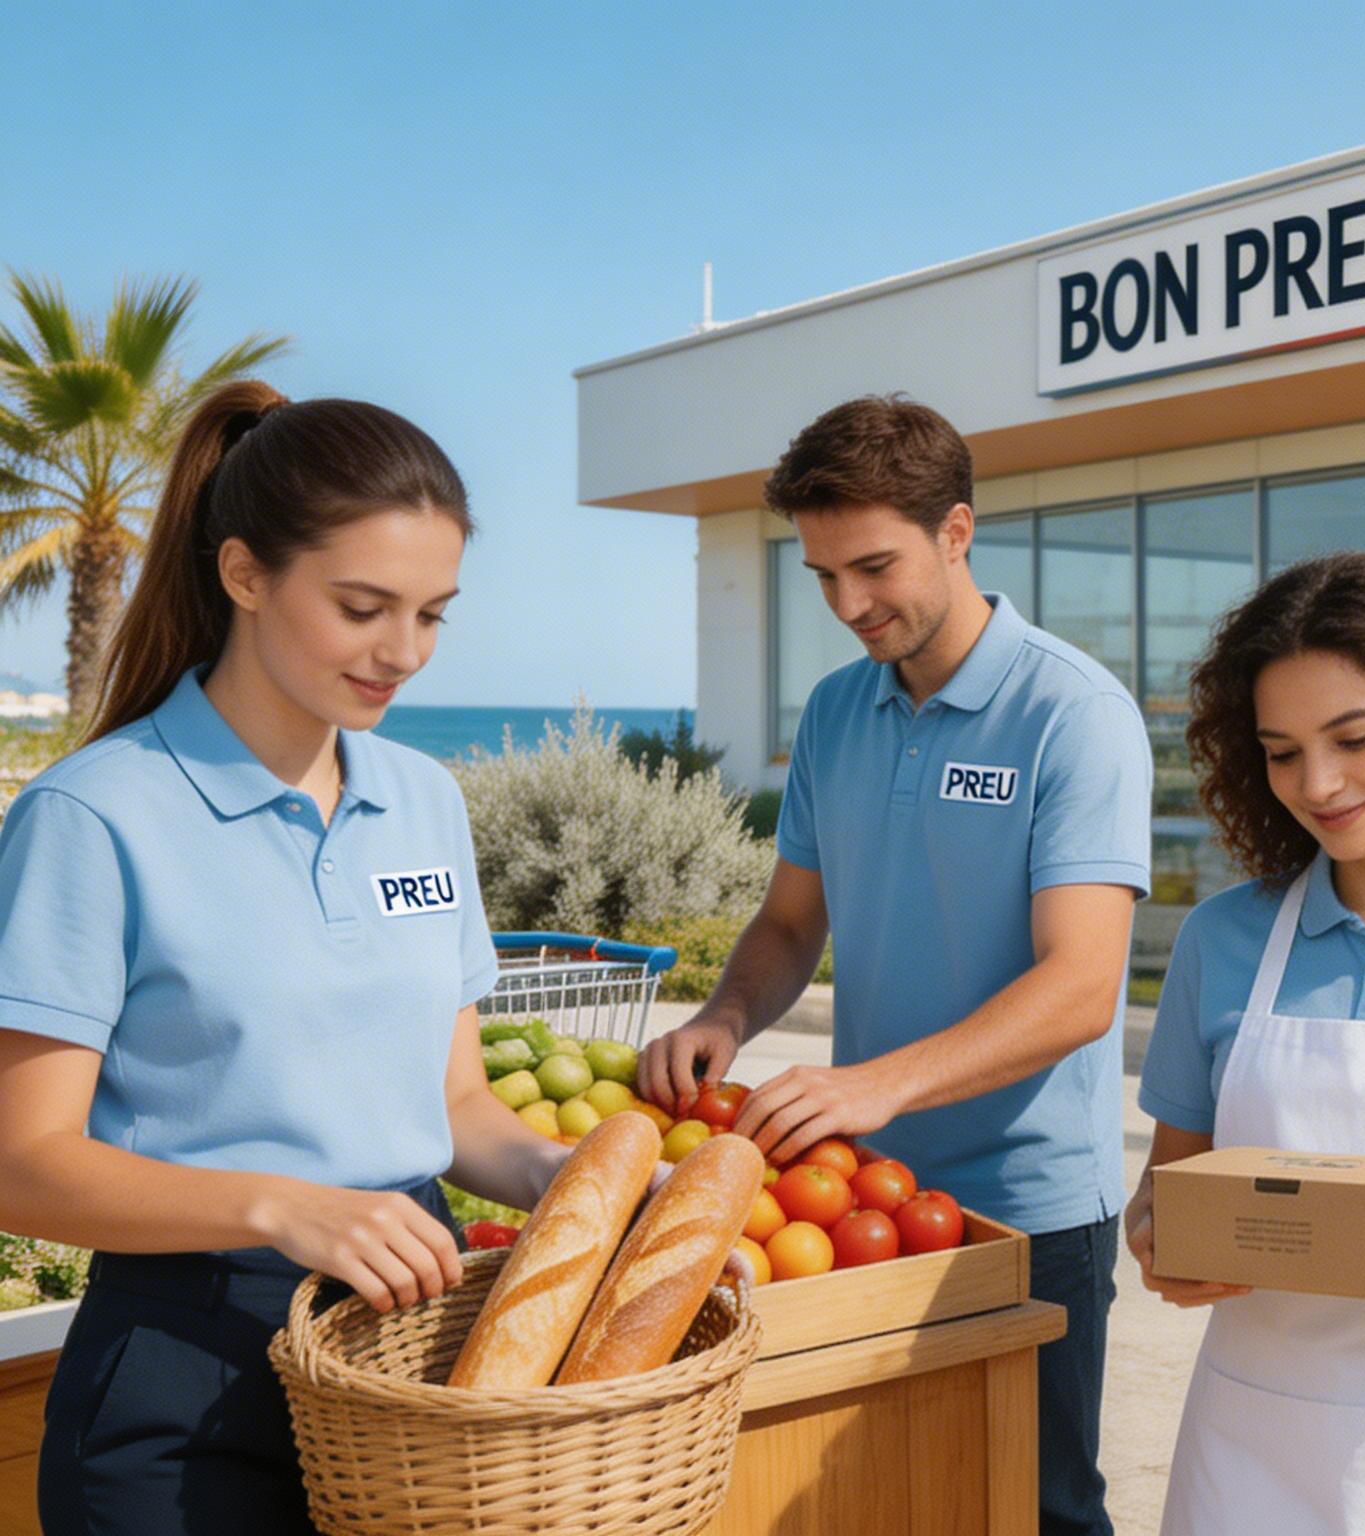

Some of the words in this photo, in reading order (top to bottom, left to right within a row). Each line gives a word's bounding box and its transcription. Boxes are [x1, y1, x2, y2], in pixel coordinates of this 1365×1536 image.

[1059, 242, 1199, 365] BON
[945, 768, 1016, 801] PREU
[378, 871, 454, 911] PREU
